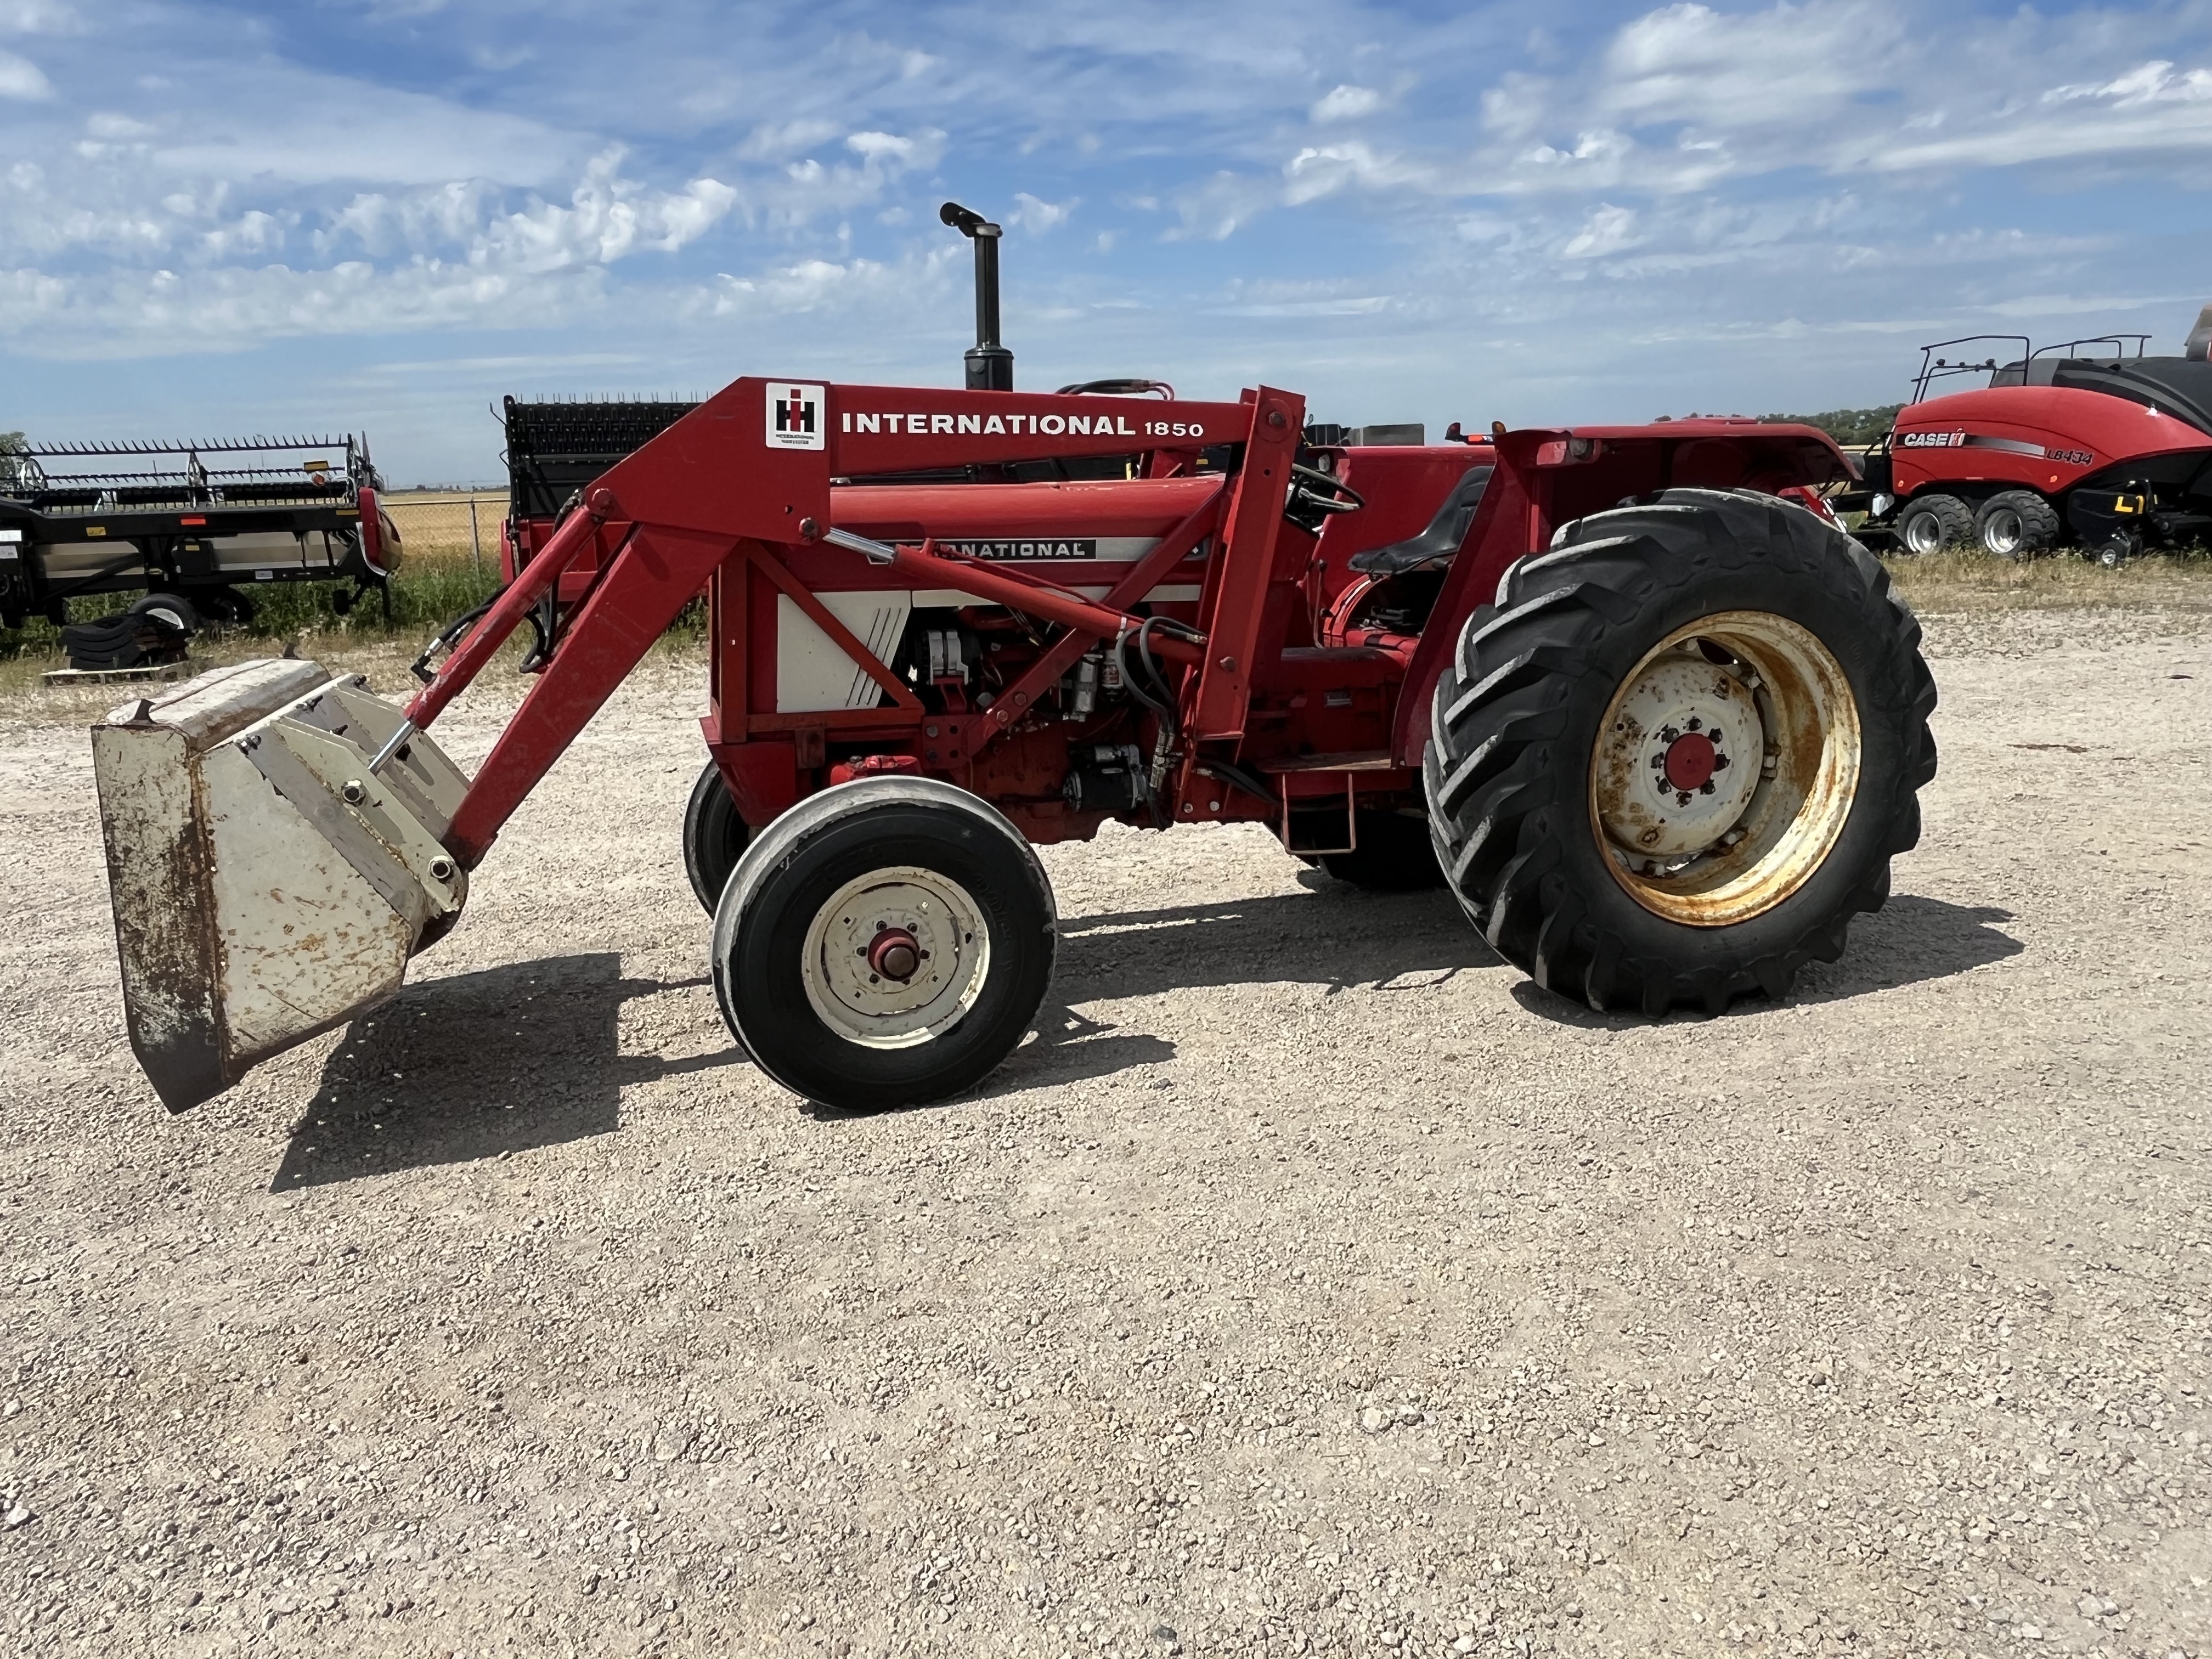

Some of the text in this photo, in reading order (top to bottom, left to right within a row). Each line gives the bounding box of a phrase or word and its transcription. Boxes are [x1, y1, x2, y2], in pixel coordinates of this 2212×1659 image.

[842, 413, 1204, 437] INTERNATIONAL 1850
[1904, 433, 1949, 447] CASE
[2046, 449, 2094, 466] LB434
[909, 542, 1086, 557] NATIONAL
